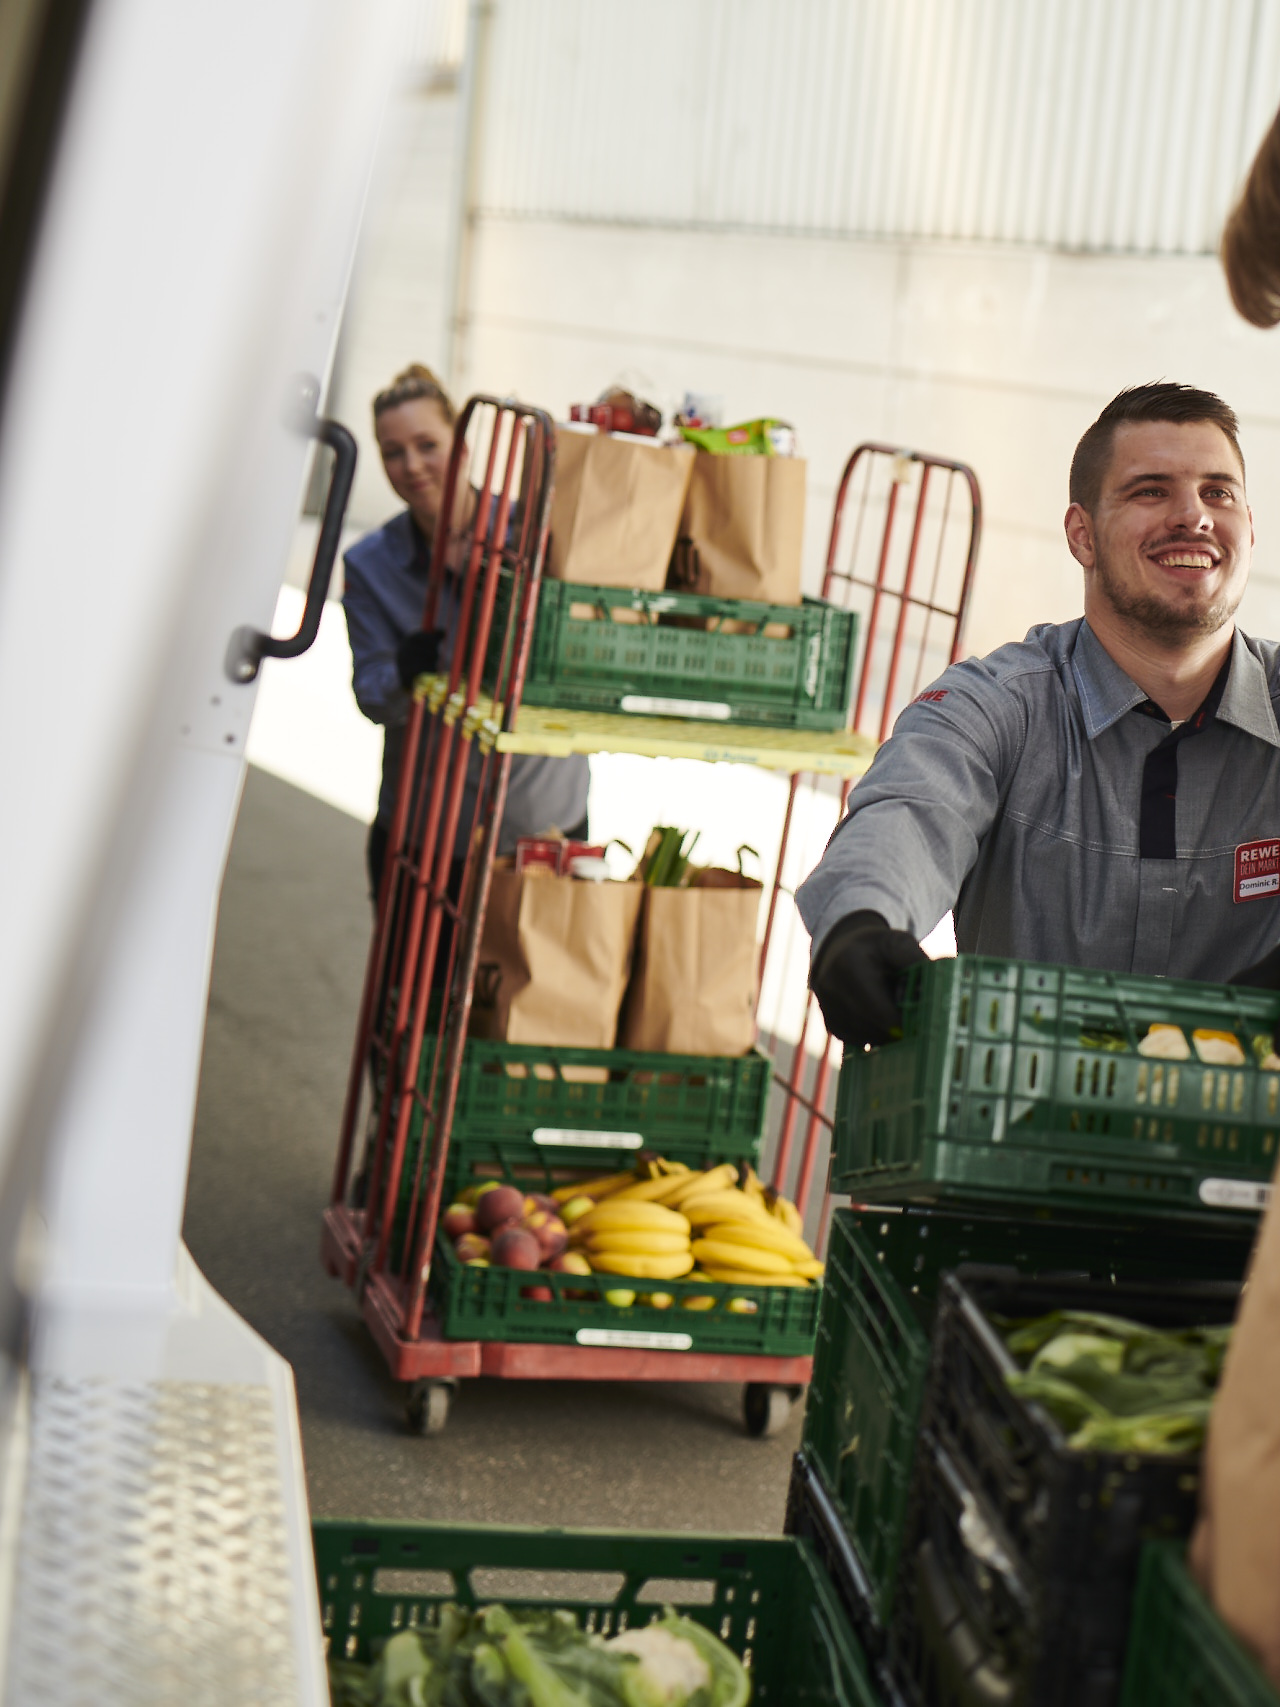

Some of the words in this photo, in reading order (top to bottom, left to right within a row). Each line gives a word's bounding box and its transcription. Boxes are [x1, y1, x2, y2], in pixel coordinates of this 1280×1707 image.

[1241, 845, 1280, 862] REWE
[1241, 861, 1256, 875] DEIN
[1258, 858, 1279, 871] MARKT
[1240, 880, 1270, 889] Dominic
